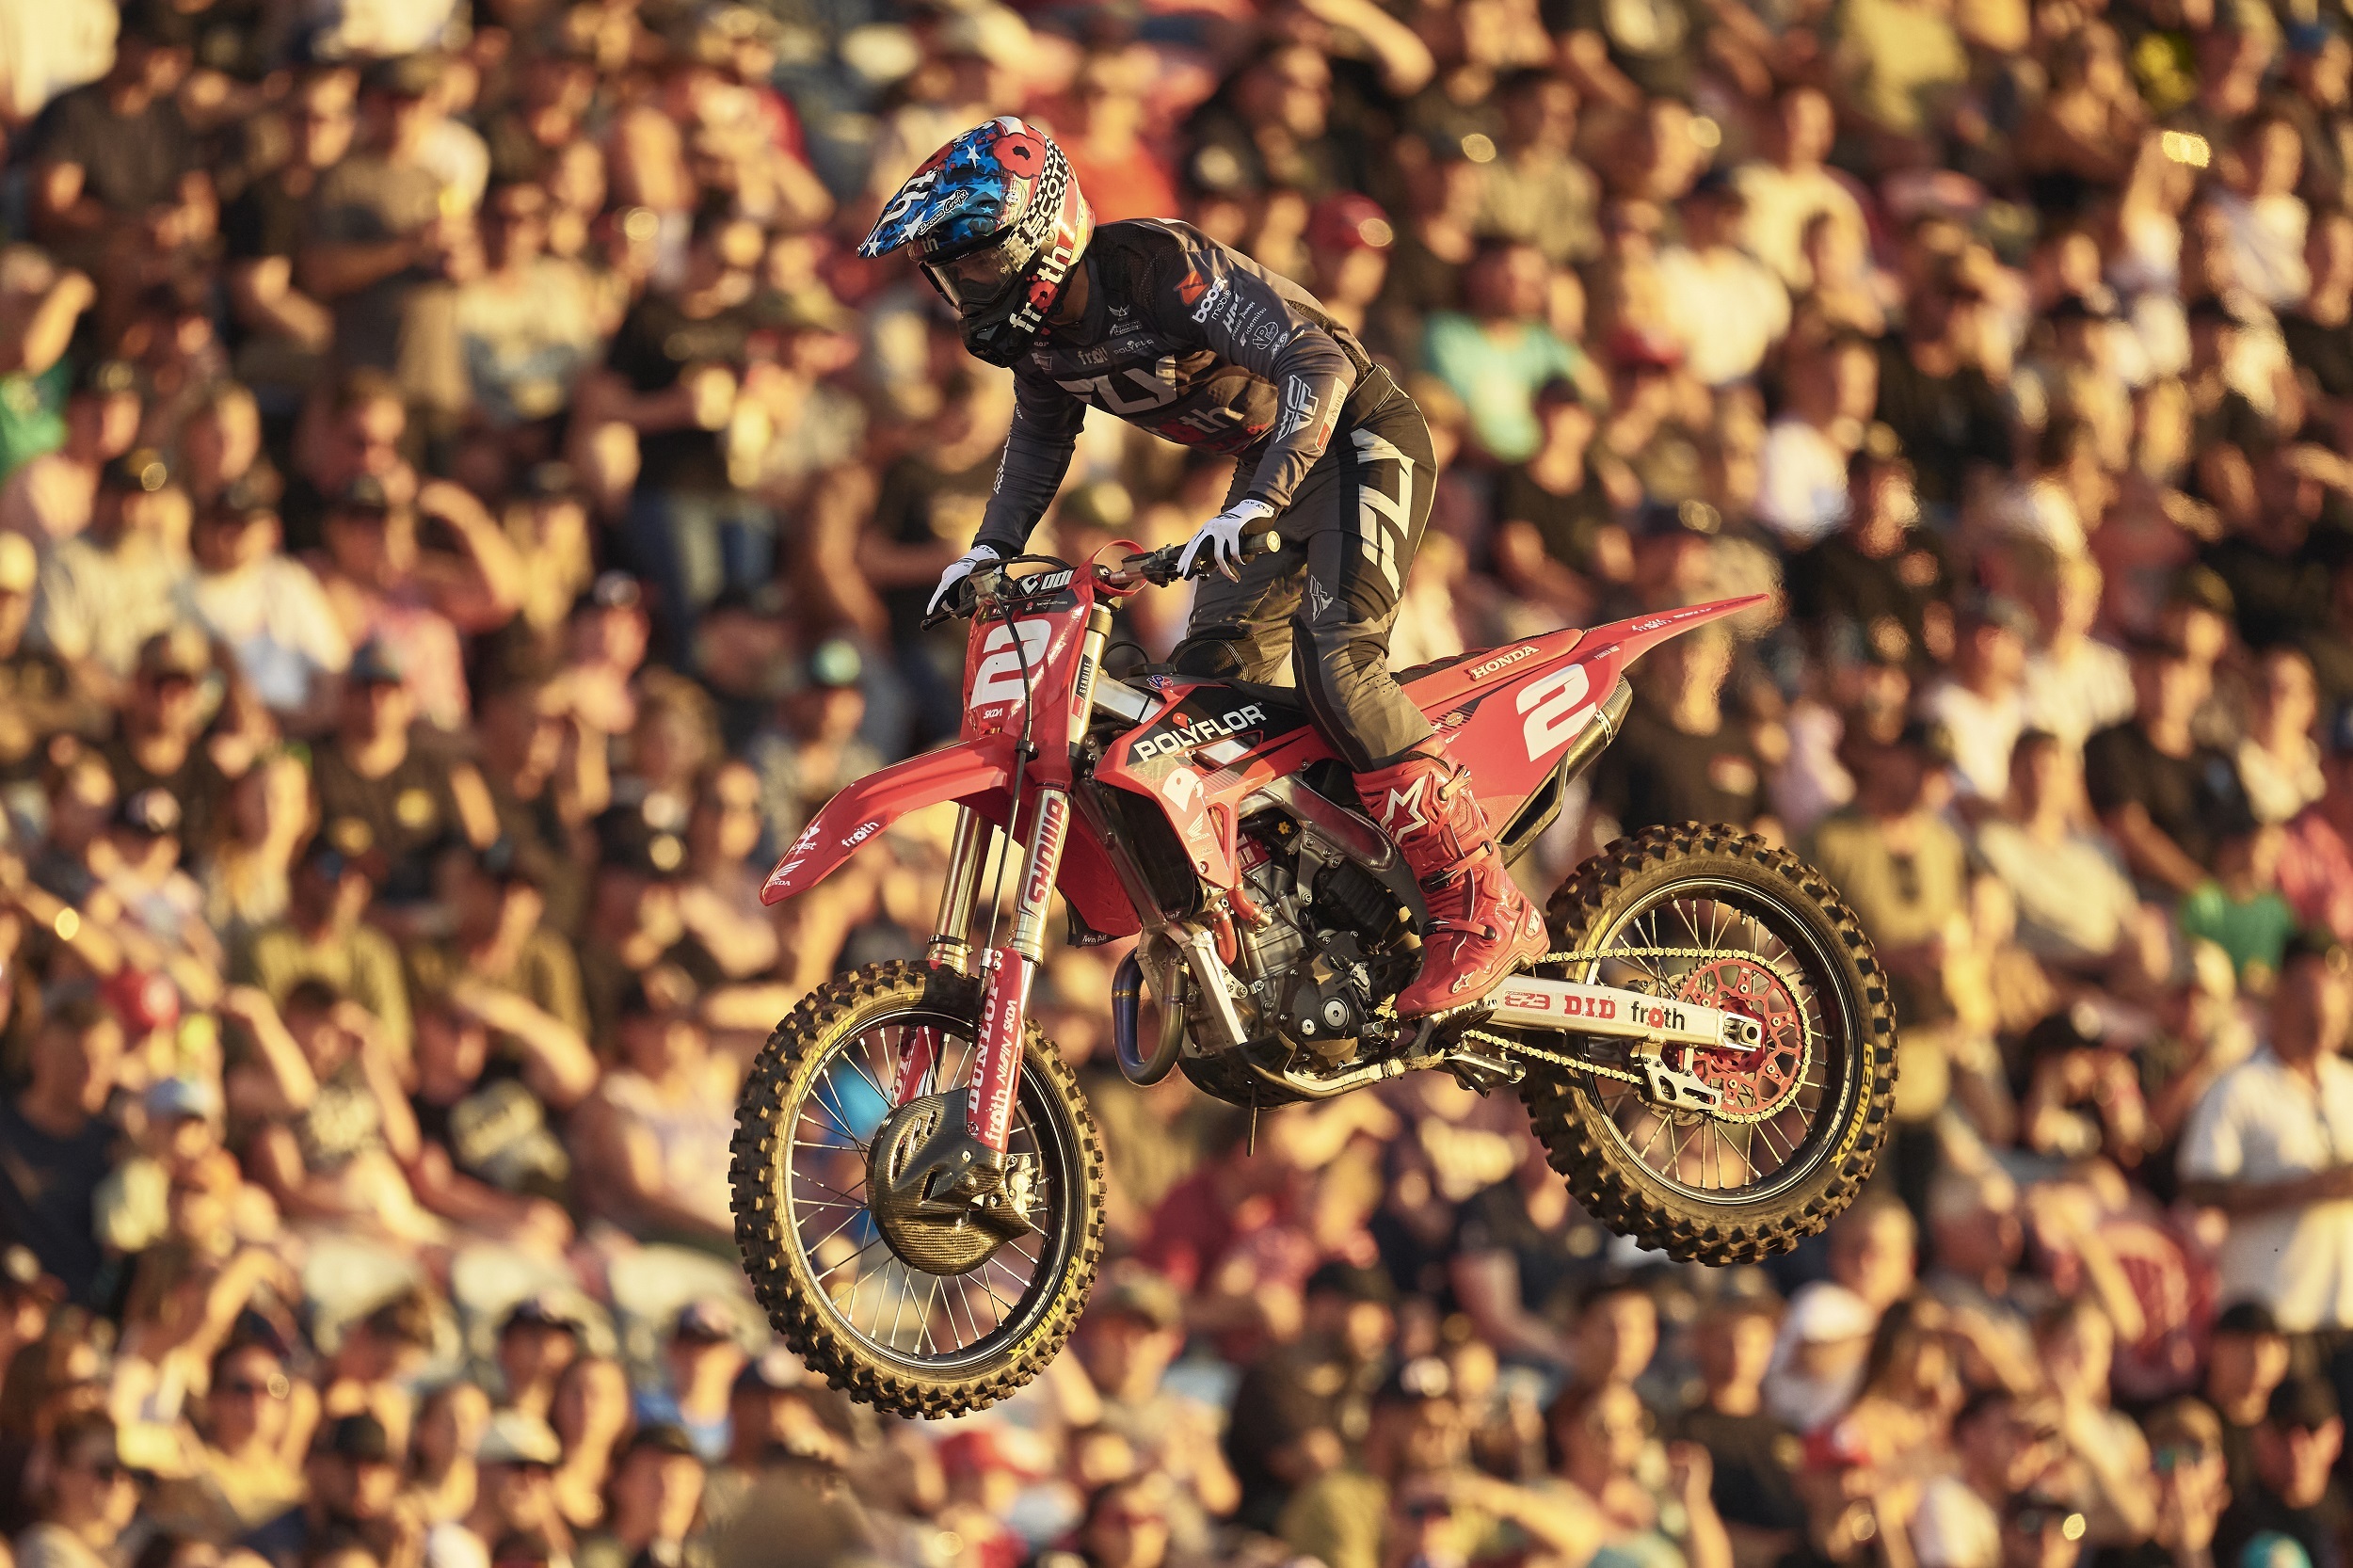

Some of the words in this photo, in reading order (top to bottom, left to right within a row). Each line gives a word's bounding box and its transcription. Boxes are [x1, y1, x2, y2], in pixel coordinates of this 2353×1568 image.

[1029, 152, 1065, 235] SCOTT
[1009, 245, 1072, 333] froth
[1192, 275, 1227, 323] boost
[1211, 289, 1232, 320] mobile
[1245, 307, 1267, 335] idemitsu
[1330, 390, 1345, 423] GENUINE
[1351, 427, 1415, 600] FLY
[969, 617, 1052, 710] 2
[1080, 661, 1092, 695] GENUINE
[1471, 645, 1540, 679] HONDA
[983, 708, 1003, 719] SKDA
[1133, 704, 1267, 762] POLYFLOR
[1516, 663, 1598, 762] 2
[841, 822, 879, 847] froth
[1028, 797, 1064, 903] SHOWA
[1190, 833, 1210, 843] HONDA
[968, 975, 1000, 1114] DUNLOP
[1630, 1001, 1686, 1031] froth
[984, 1089, 1007, 1142] froth
[1004, 1000, 1017, 1033] SKDA
[1829, 1043, 1874, 1169] GEOMAX
[1006, 1256, 1080, 1360] GEOMAX
